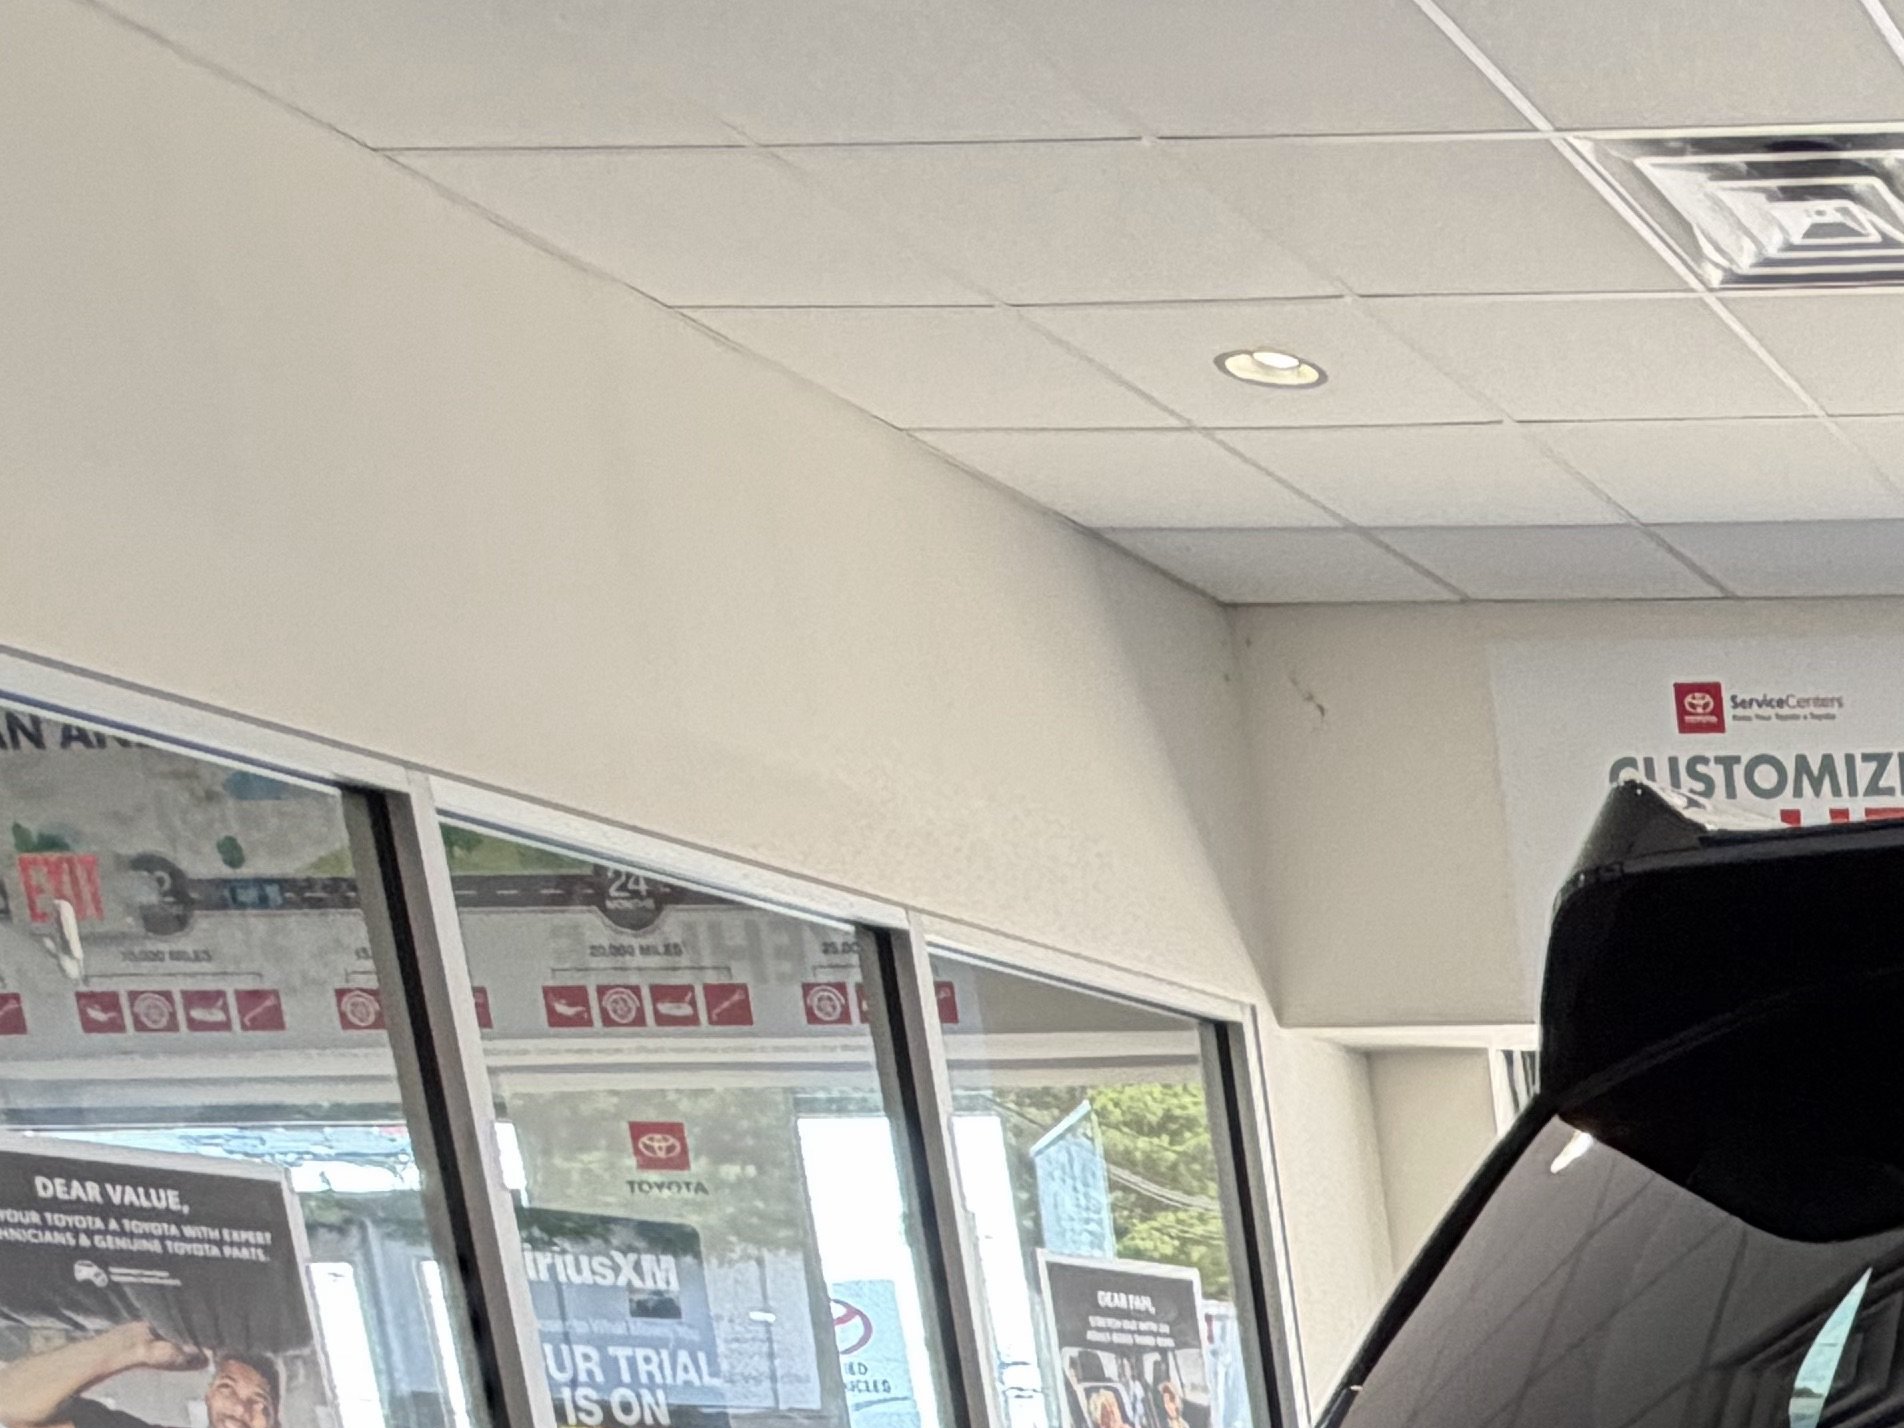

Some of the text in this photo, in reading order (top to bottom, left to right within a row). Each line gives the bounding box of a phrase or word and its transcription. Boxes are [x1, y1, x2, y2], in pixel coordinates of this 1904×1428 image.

[34, 1175, 191, 1215] DEAR VALUE,
[626, 1180, 710, 1195] TOYOTA
[524, 1243, 680, 1291] iriusXM
[543, 1343, 724, 1387] UR TRIAL
[560, 1386, 672, 1427] IS ON
